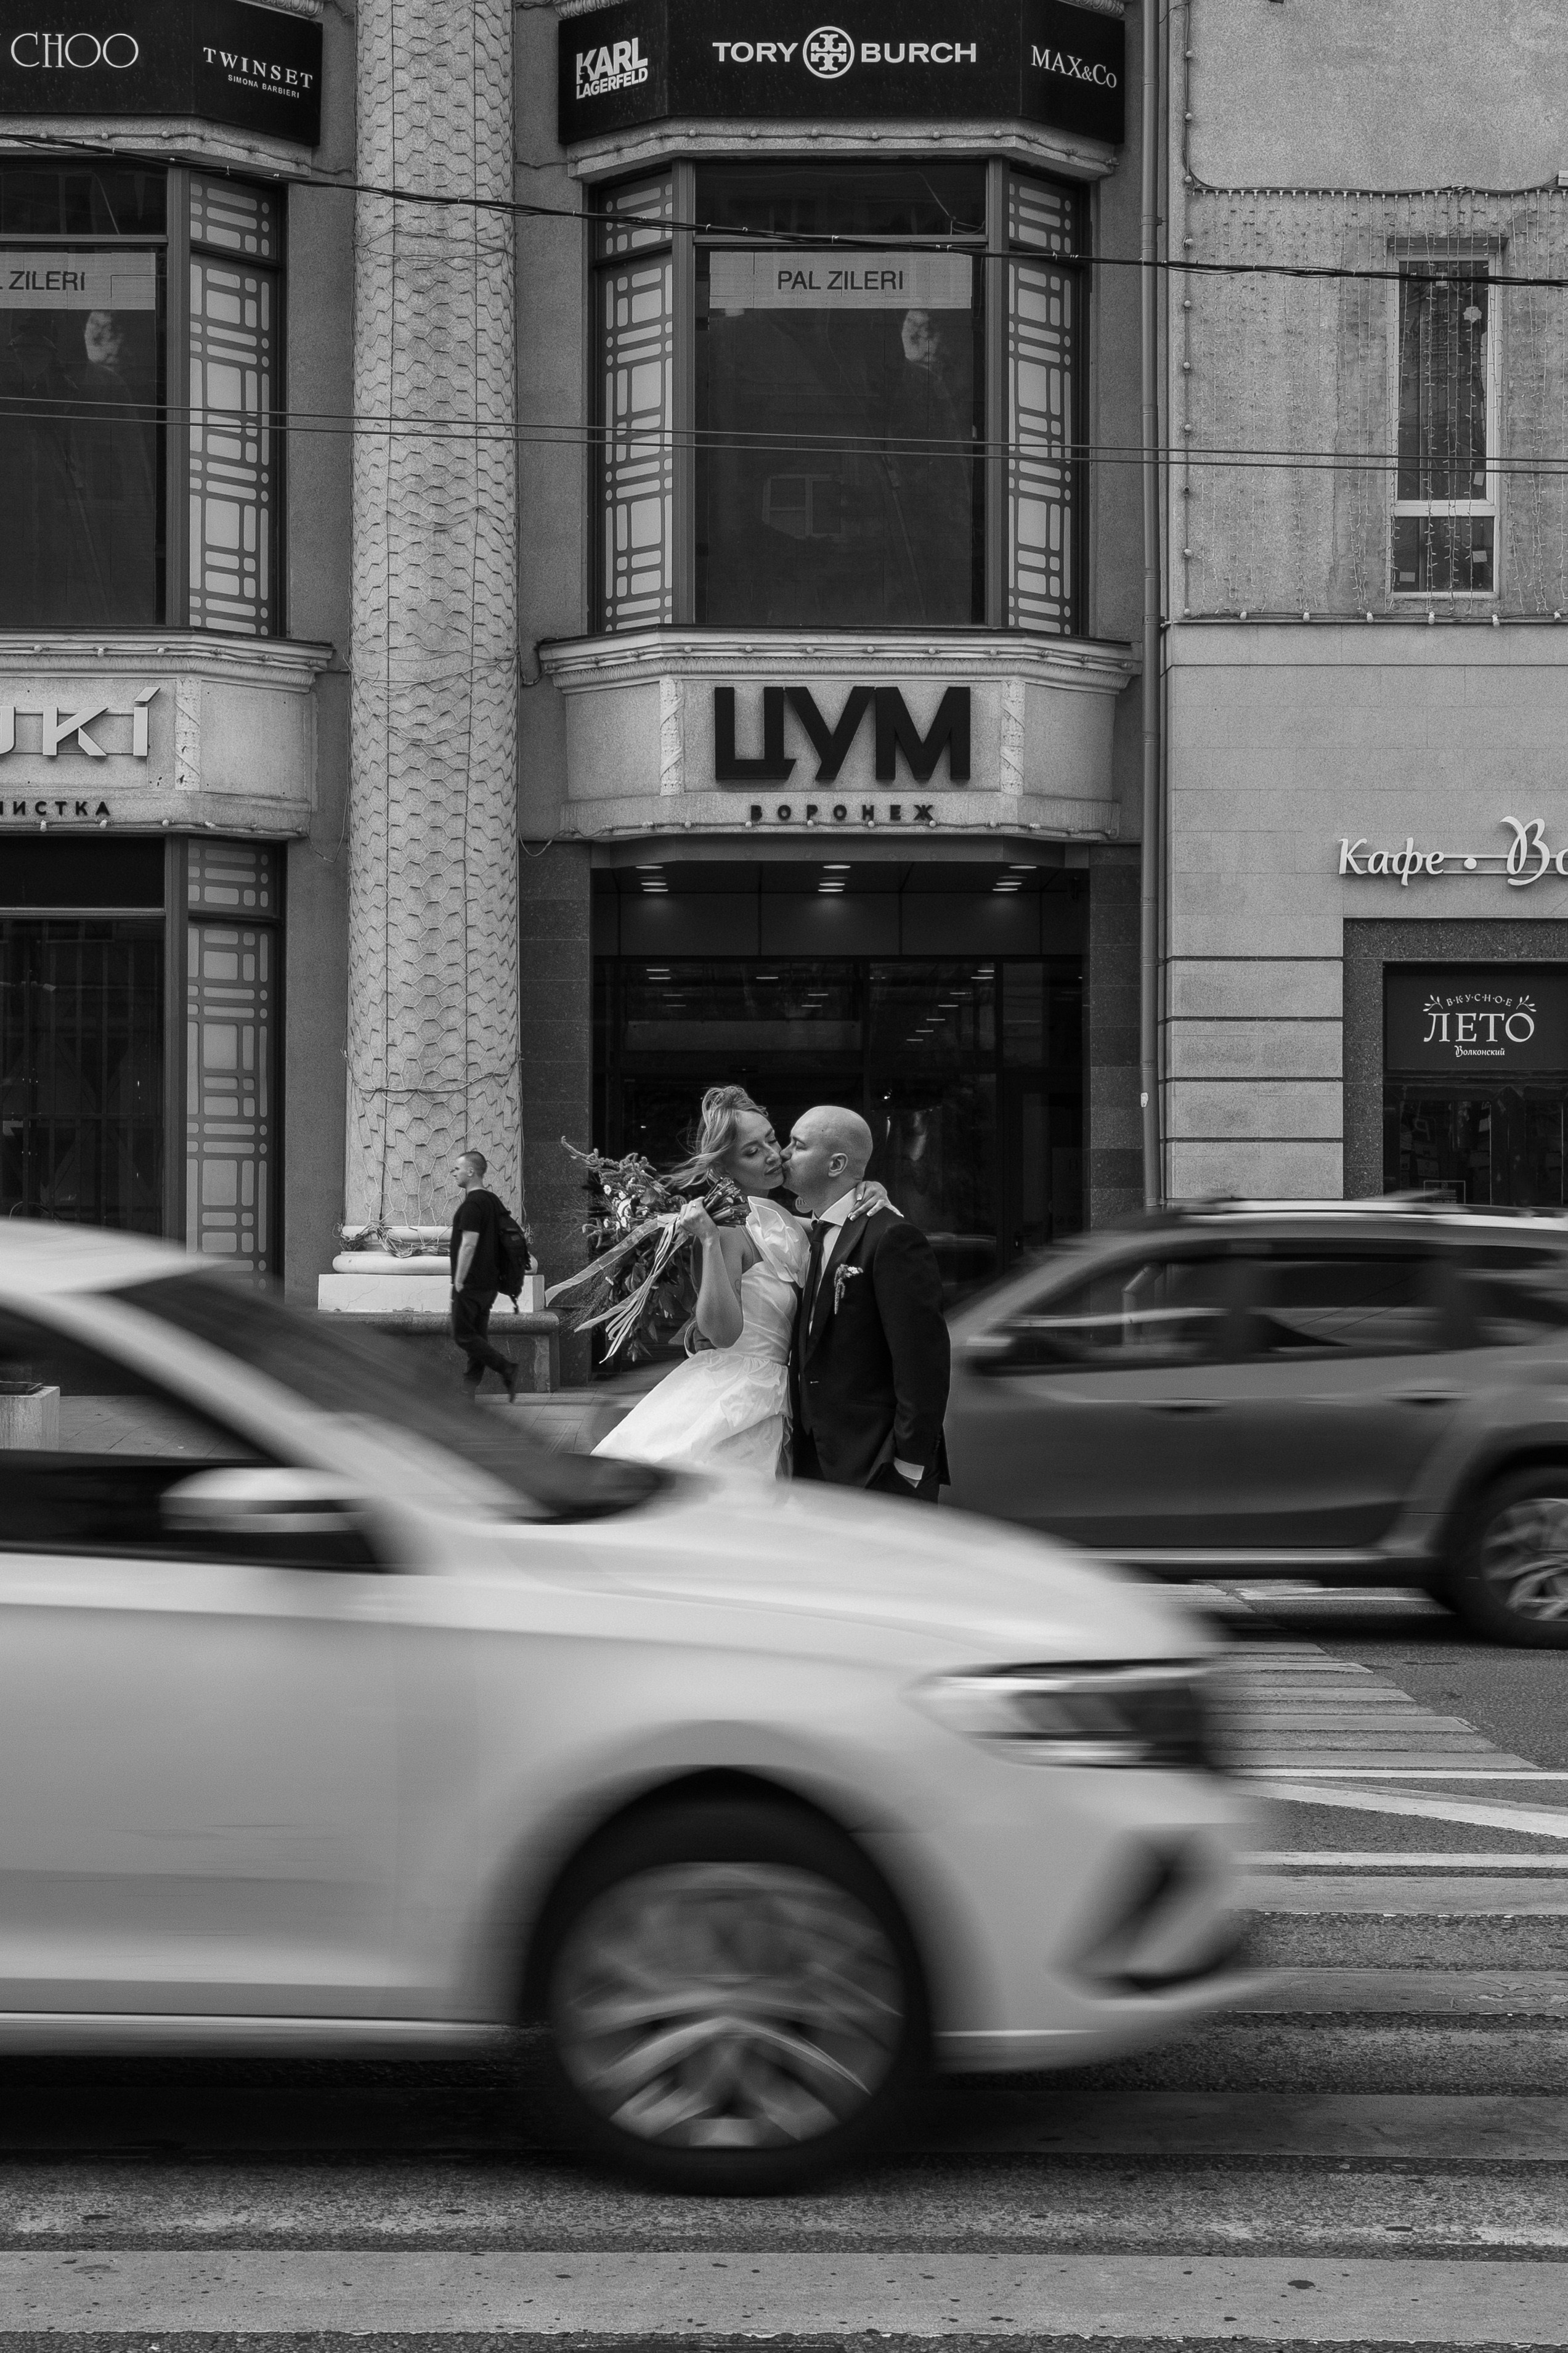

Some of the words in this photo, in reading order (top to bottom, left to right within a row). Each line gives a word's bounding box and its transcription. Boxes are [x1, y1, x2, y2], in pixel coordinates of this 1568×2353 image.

[11, 32, 139, 68] CHOO
[576, 37, 648, 84] KARL
[712, 42, 798, 63] TORY
[861, 42, 977, 63] BURCH
[203, 47, 313, 89] TWINSET
[228, 75, 258, 88] SIMONA
[262, 83, 299, 99] BARBIERI
[576, 67, 648, 100] LAGERFELD
[9, 271, 85, 291] ZILERI
[778, 271, 821, 290] PAL
[827, 270, 903, 290] ZILERI
[715, 686, 971, 780] ЦУМ
[0, 801, 110, 816] ИСТКА
[750, 804, 933, 821] ВОРОНЕЖ
[1338, 837, 1445, 886] Кафе
[1423, 1013, 1535, 1043] ЛЕТО
[1454, 1045, 1505, 1058] Волконский
